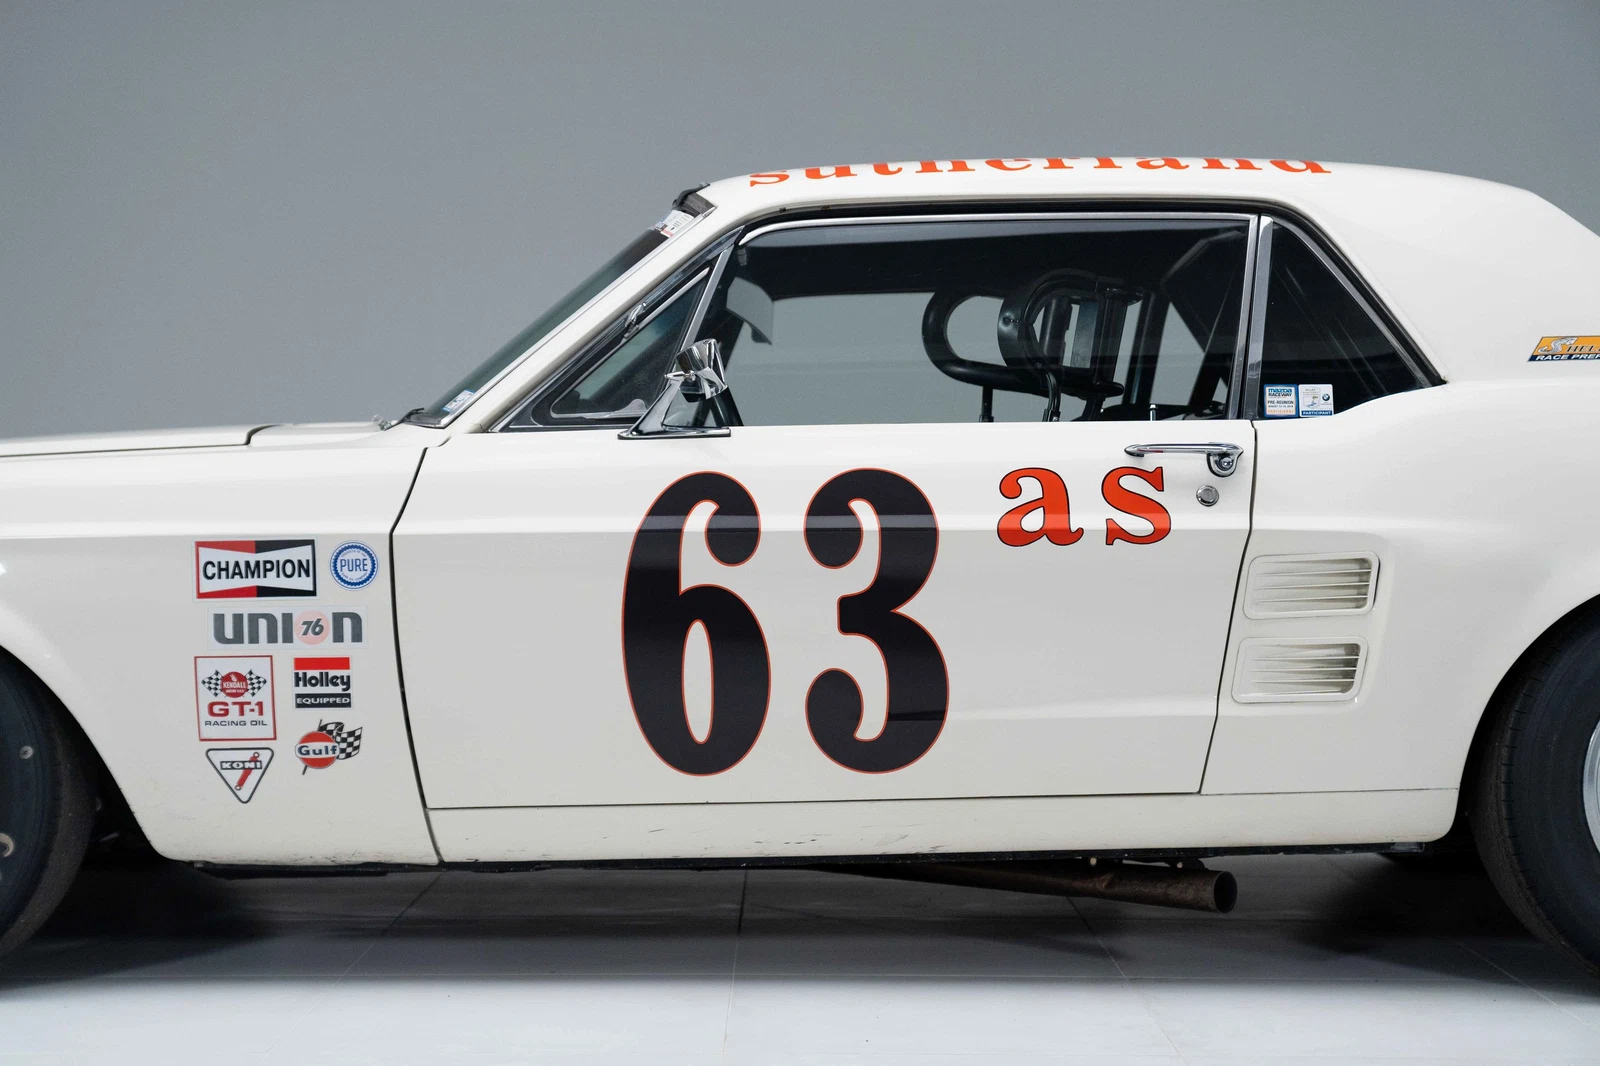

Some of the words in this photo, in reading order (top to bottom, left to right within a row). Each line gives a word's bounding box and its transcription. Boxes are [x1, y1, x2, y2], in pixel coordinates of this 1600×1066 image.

[996, 466, 1172, 547] as
[202, 558, 311, 580] CHAMPION
[340, 558, 368, 572] PURE
[301, 618, 325, 636] 76
[622, 468, 949, 776] 63
[294, 671, 351, 692] Holley
[207, 701, 264, 717] GT-1
[204, 719, 247, 727] RACING
[297, 745, 338, 756] Gulf
[221, 761, 262, 769] KONI
